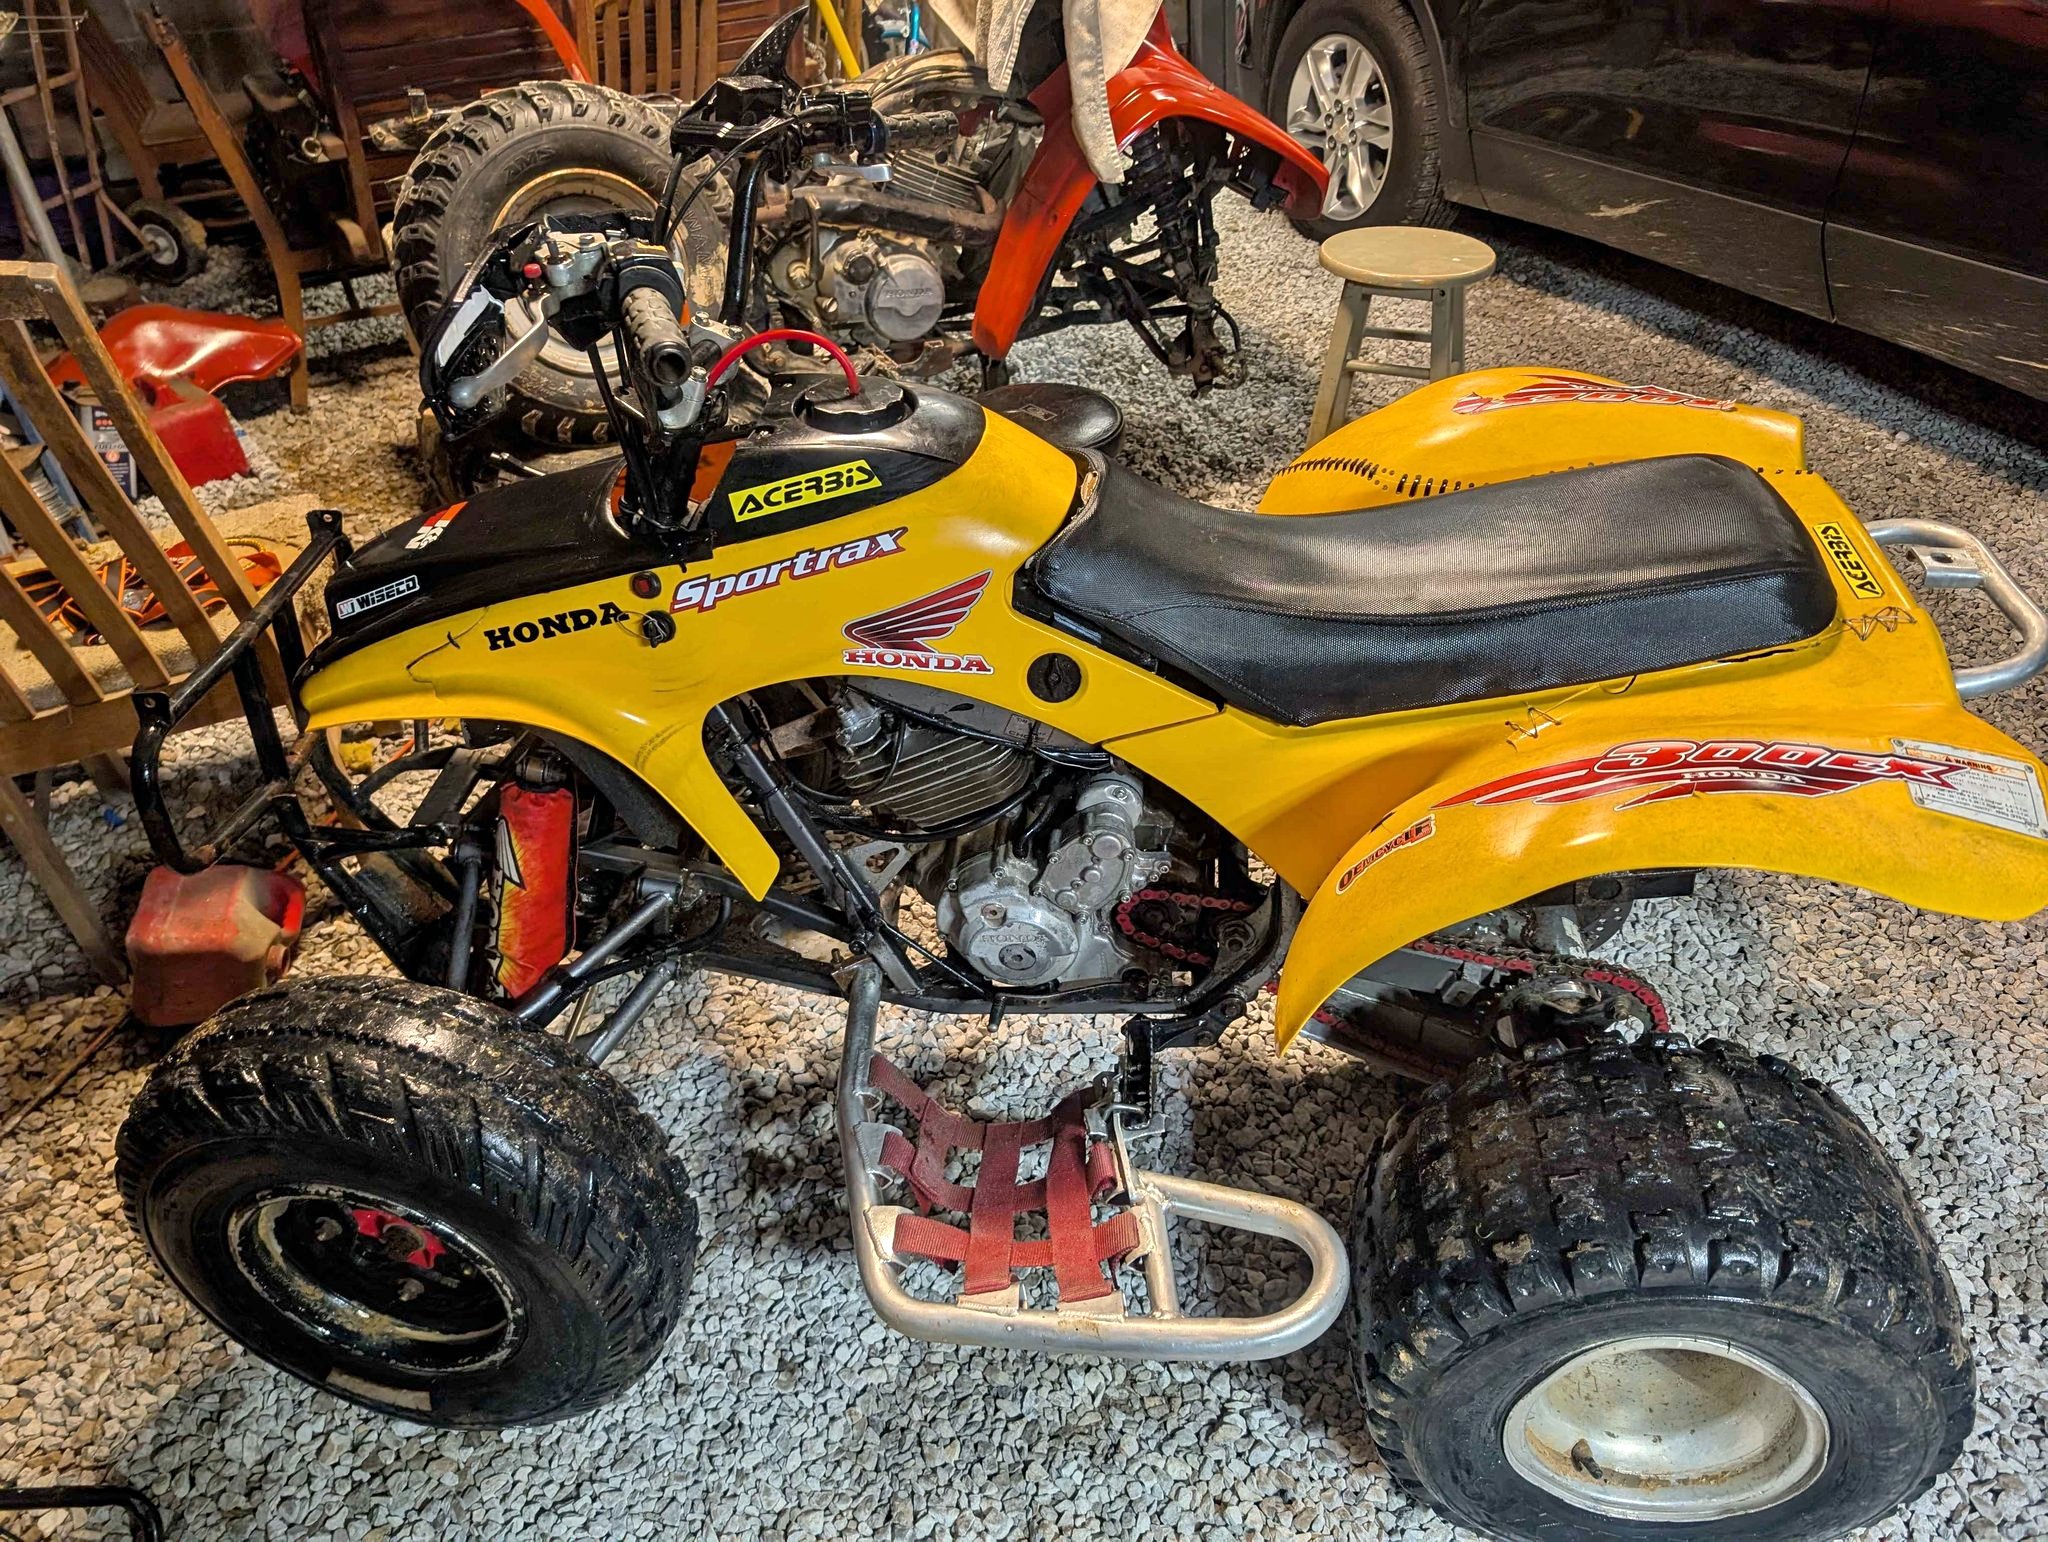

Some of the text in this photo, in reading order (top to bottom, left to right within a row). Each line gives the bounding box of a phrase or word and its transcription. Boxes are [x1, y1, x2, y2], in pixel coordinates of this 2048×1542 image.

[672, 527, 908, 612] Sportrax
[483, 601, 630, 651] HONDA
[844, 650, 993, 674] HONDA
[1596, 740, 1952, 788] 300EX
[1681, 769, 1809, 784] HONDA
[1954, 758, 1993, 771] WARNING
